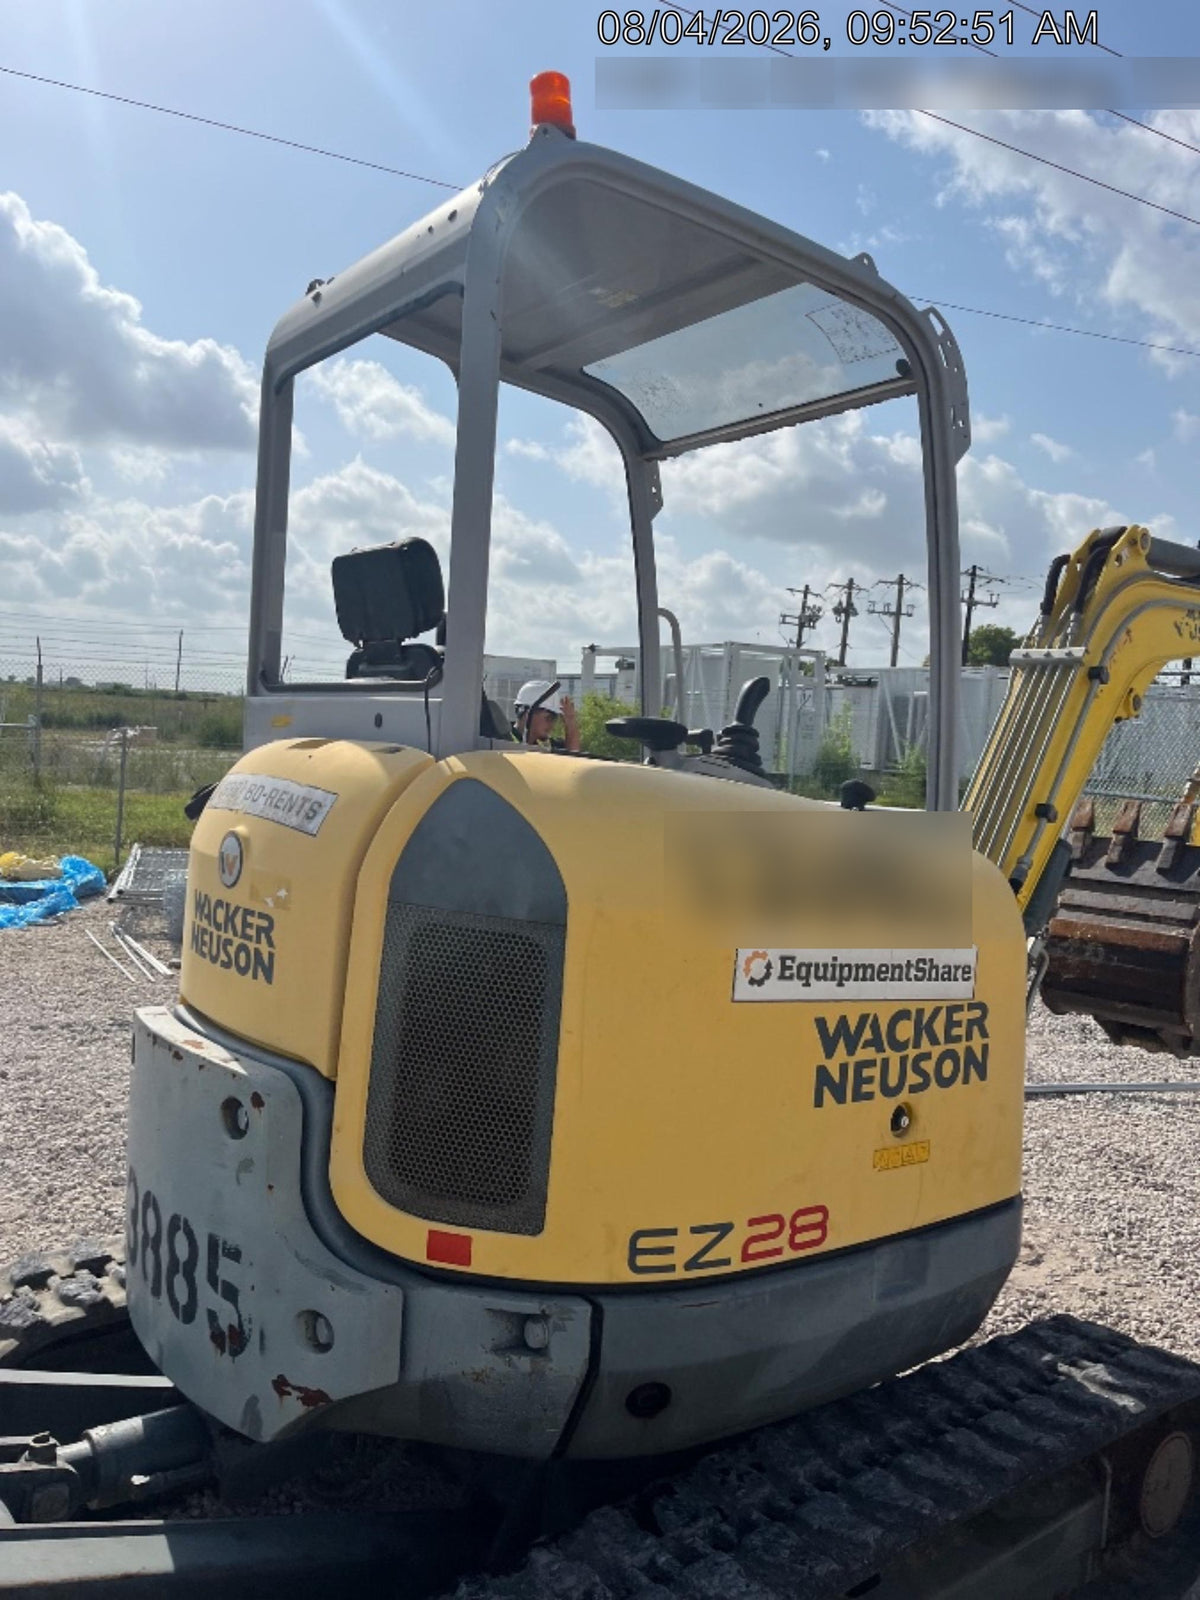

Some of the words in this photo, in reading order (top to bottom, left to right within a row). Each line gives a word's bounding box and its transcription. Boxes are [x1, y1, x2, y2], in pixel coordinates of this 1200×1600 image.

[194, 888, 276, 950] WACKER
[191, 920, 276, 986] NEUSON
[777, 955, 972, 988] EquipmentShare
[814, 1001, 990, 1060] WACKER
[813, 1043, 990, 1109] NEUSON
[627, 1204, 830, 1275] EZ28
